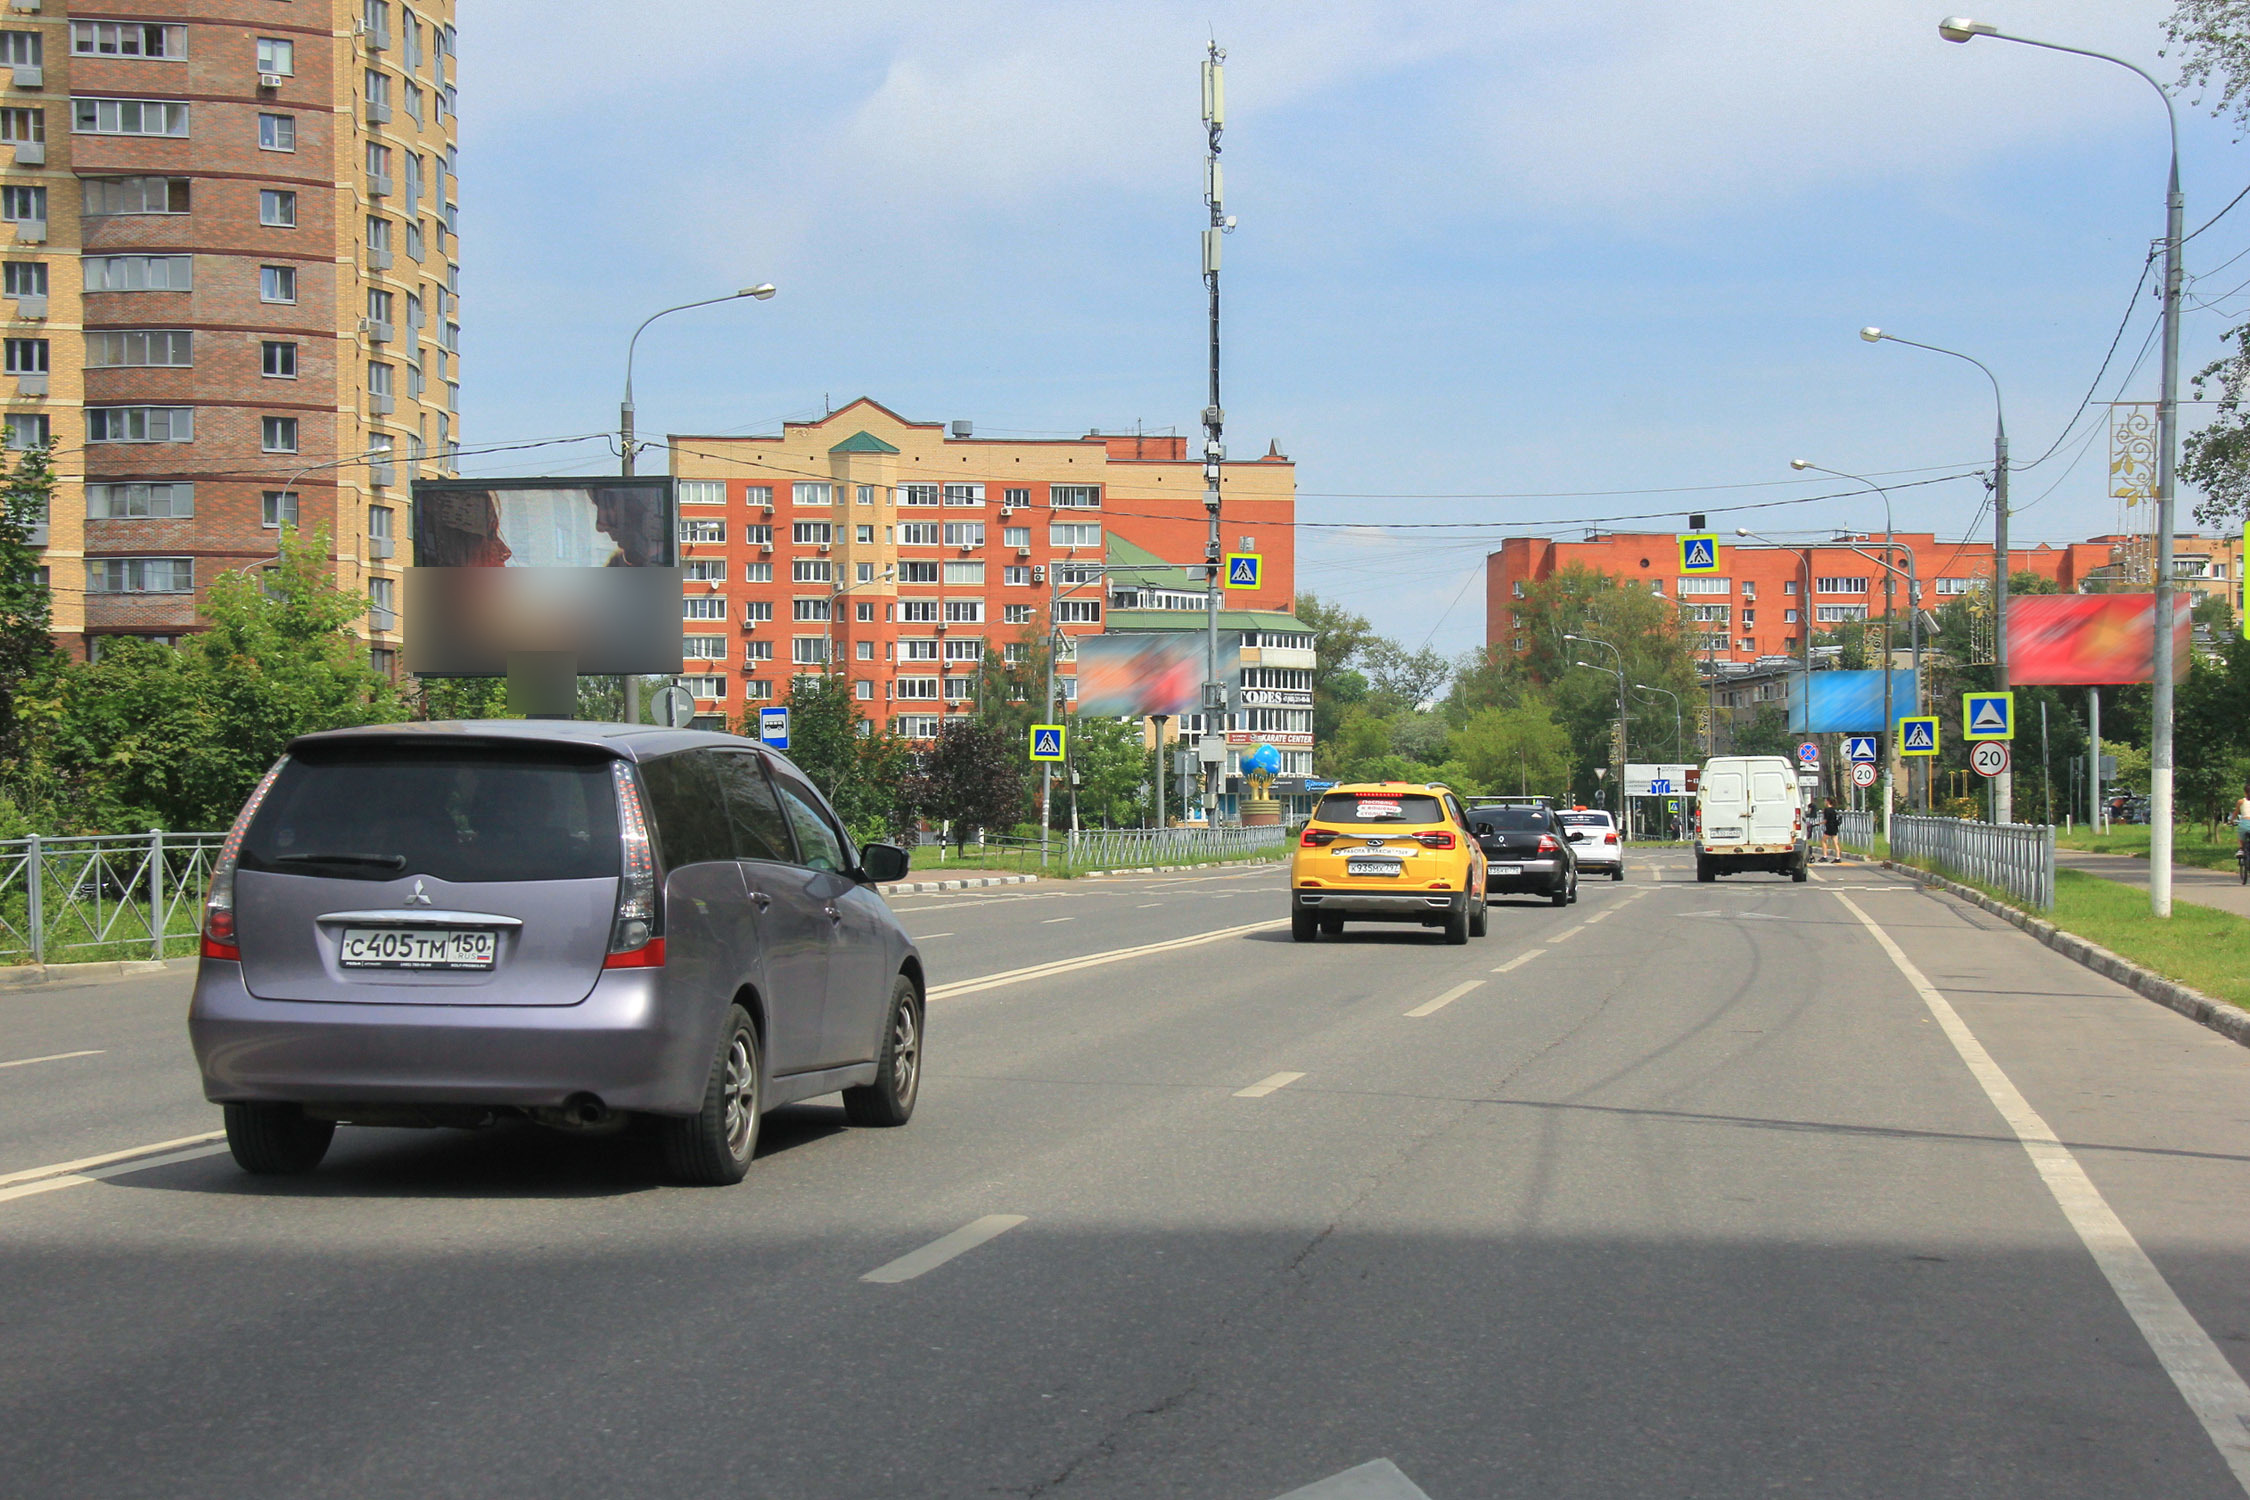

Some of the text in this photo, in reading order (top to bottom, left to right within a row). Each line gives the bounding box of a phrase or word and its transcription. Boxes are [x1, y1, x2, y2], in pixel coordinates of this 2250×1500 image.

[1262, 734, 1287, 743] KARATE
[1288, 734, 1312, 743] CENTER
[1979, 751, 2001, 766] 20
[1857, 770, 1871, 780] 20
[451, 934, 487, 953] 150
